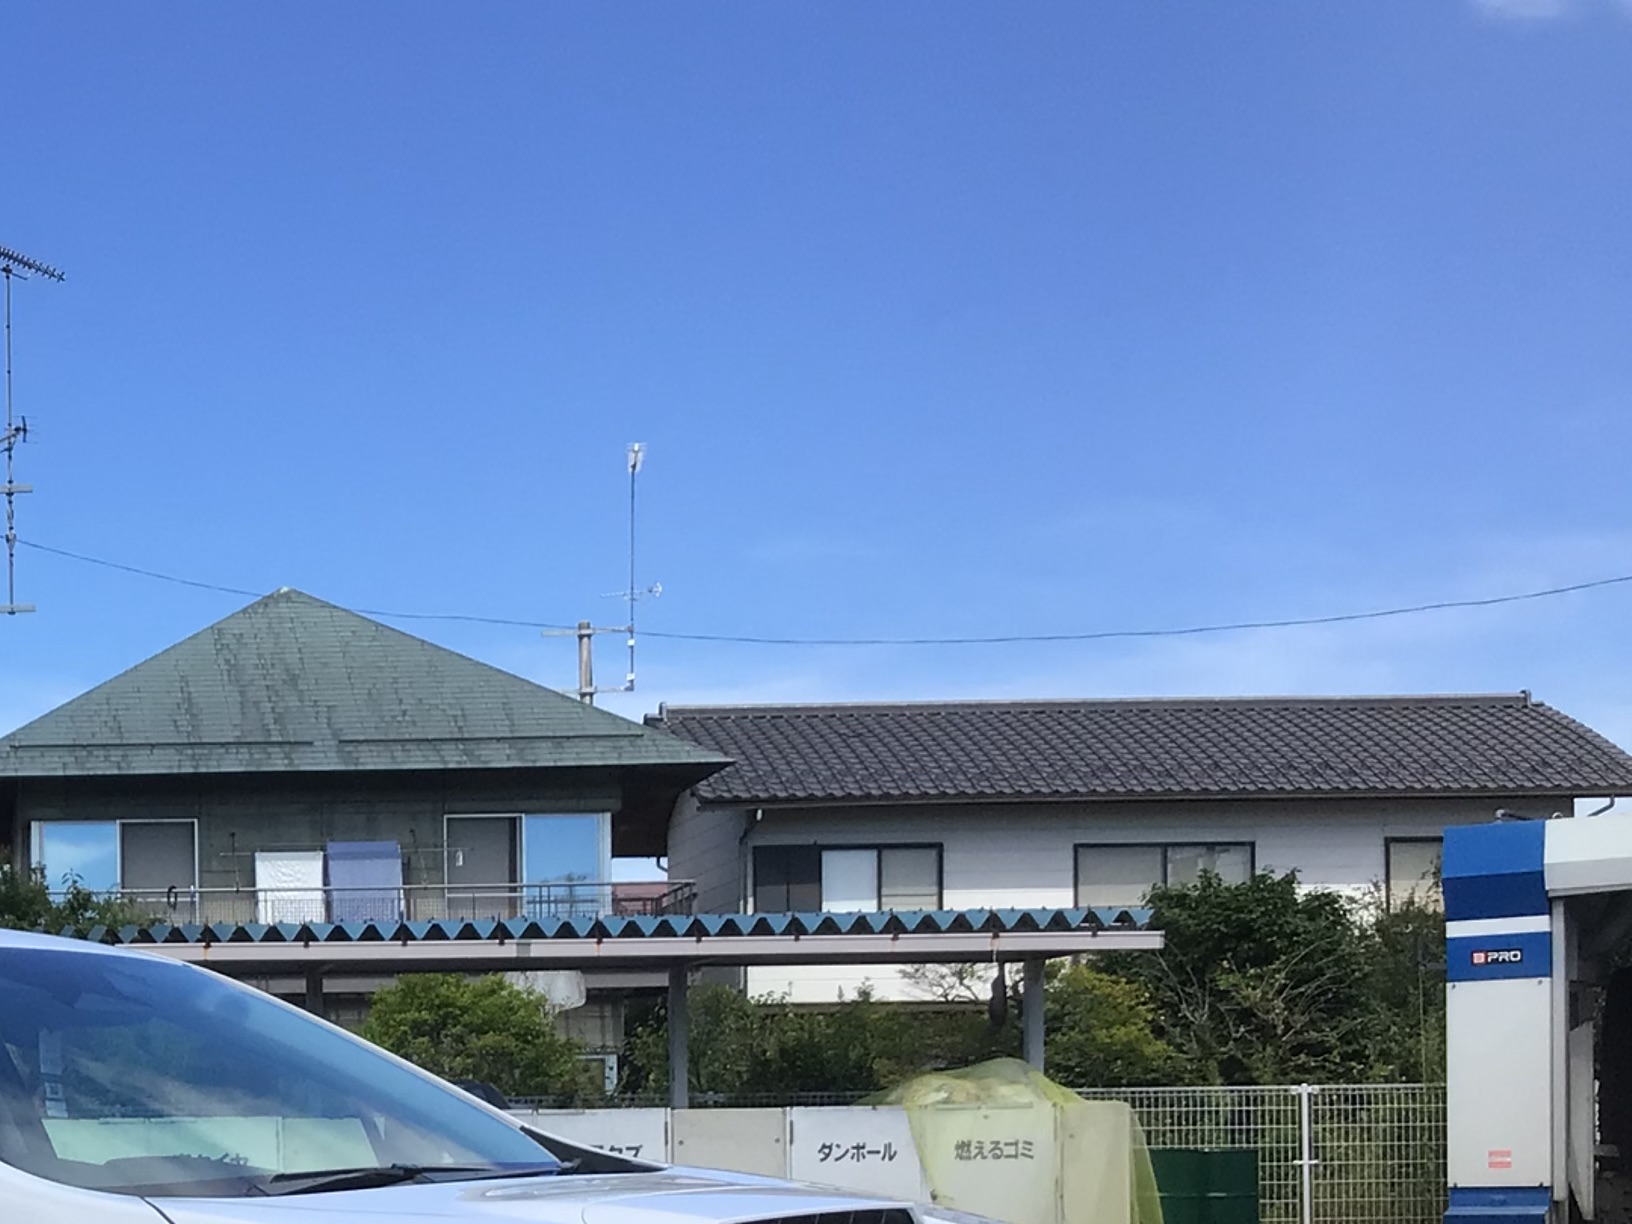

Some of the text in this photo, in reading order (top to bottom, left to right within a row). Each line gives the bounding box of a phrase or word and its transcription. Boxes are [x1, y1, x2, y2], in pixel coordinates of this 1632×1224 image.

[1487, 950, 1521, 963] PRO
[817, 1142, 897, 1162] ダンボール
[954, 1140, 1034, 1161] 燃えるゴミ
